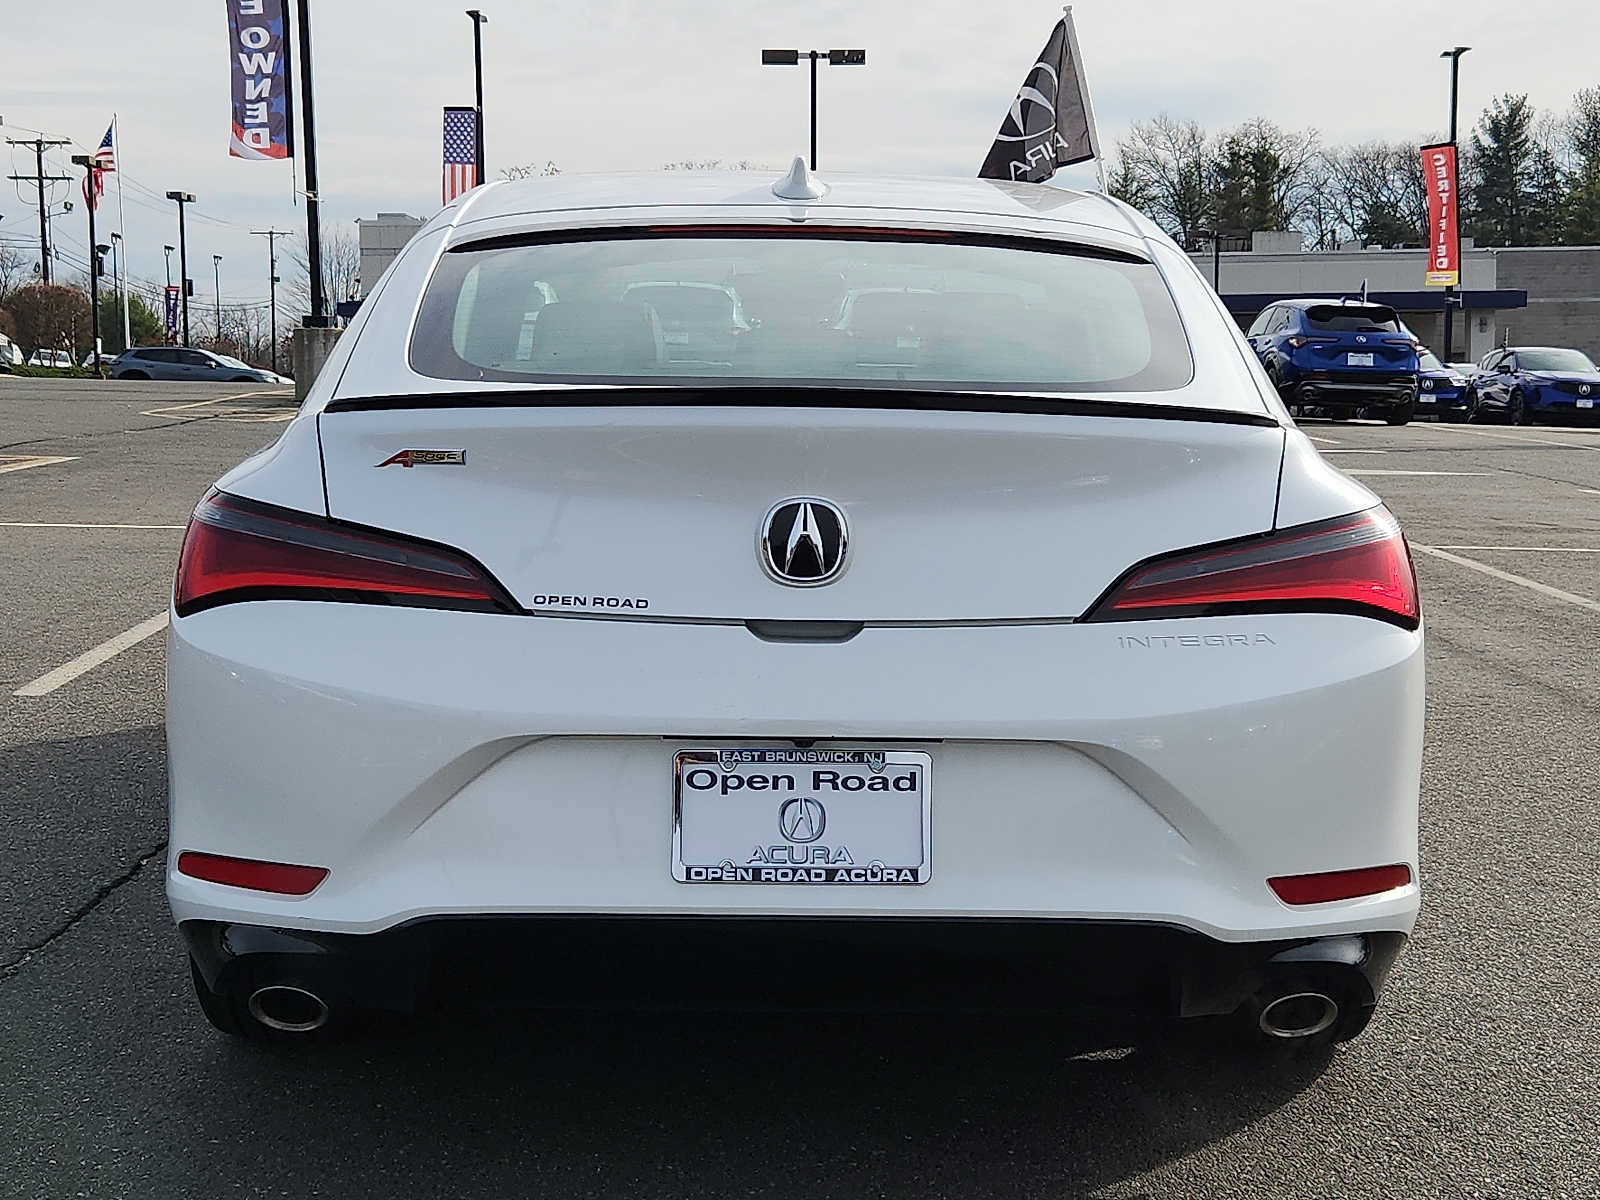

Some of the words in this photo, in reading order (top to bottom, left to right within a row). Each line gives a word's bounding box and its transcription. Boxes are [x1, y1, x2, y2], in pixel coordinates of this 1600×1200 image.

[533, 595, 587, 608] OPEN
[592, 596, 649, 609] ROAD
[1117, 633, 1277, 648] INTEGRA
[721, 751, 761, 762] EAST
[765, 751, 859, 763] BRUNSWICK,
[864, 752, 884, 764] NJ
[685, 770, 795, 795] Open
[812, 771, 917, 792] Road
[746, 845, 854, 864] ACURA
[690, 868, 752, 881] OPEN
[760, 868, 826, 882] ROAD
[833, 868, 913, 882] ACURA
